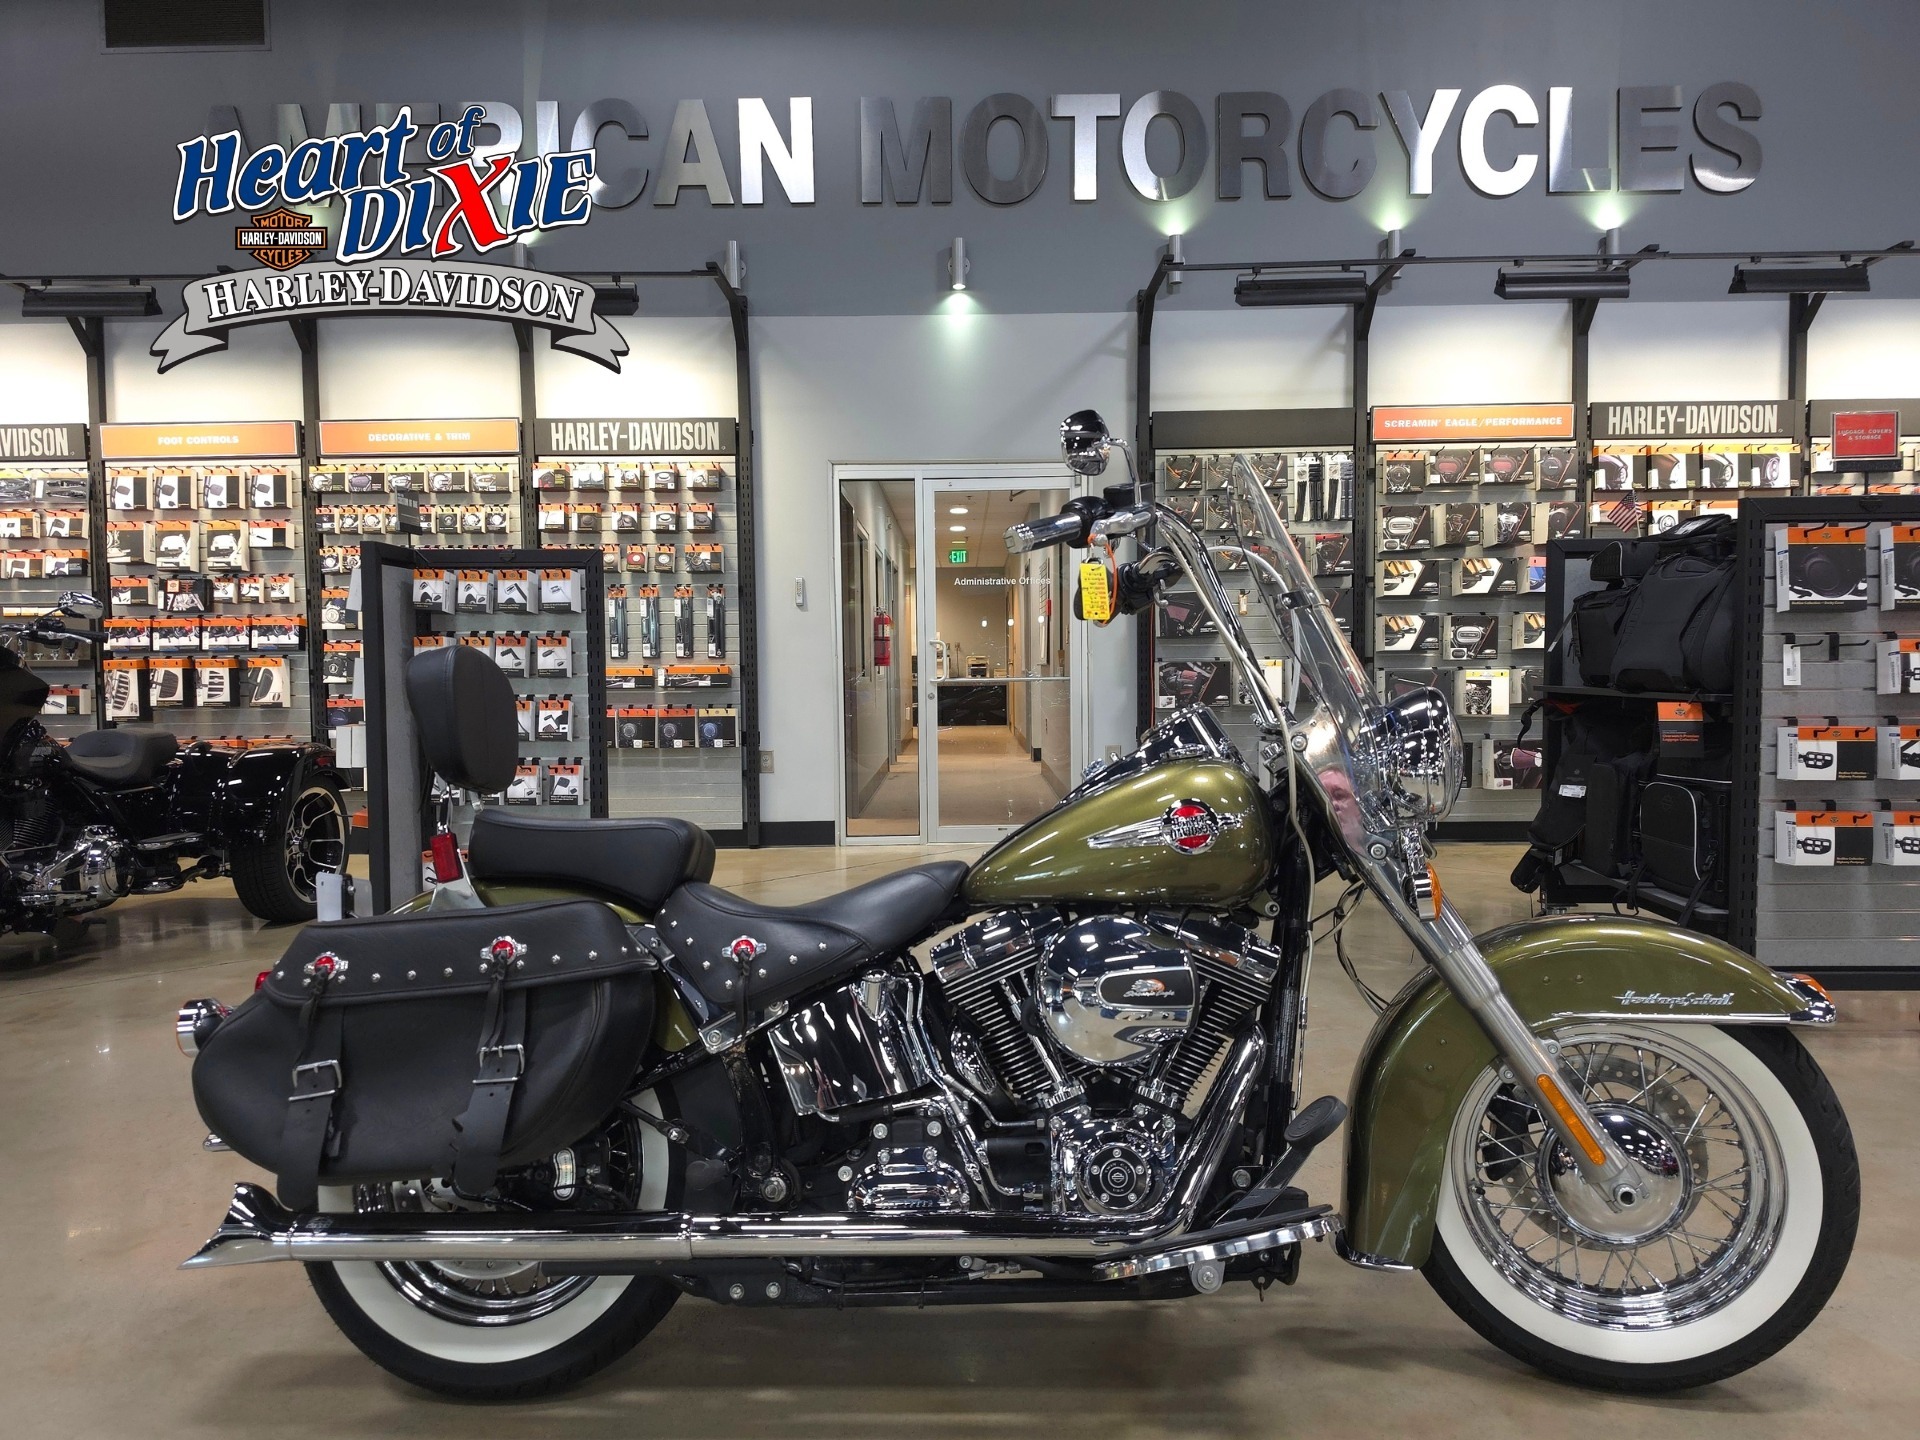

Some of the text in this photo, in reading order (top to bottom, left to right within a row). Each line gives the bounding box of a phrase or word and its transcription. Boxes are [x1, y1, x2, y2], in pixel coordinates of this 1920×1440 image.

[859, 84, 1763, 203] MOTORCYCLES
[1384, 419, 1442, 428] SCREAMIN'
[1608, 404, 1778, 435] HARLEY-DAVIDSON
[0, 427, 69, 457] VIDSON
[158, 435, 239, 445] FOOT CONTROLS
[368, 432, 471, 442] DECORATIVE & TRIM
[550, 421, 720, 451] HARLEY-DAVIDSON
[951, 550, 967, 563] EXIT
[954, 576, 1051, 586] Administrative Offices
